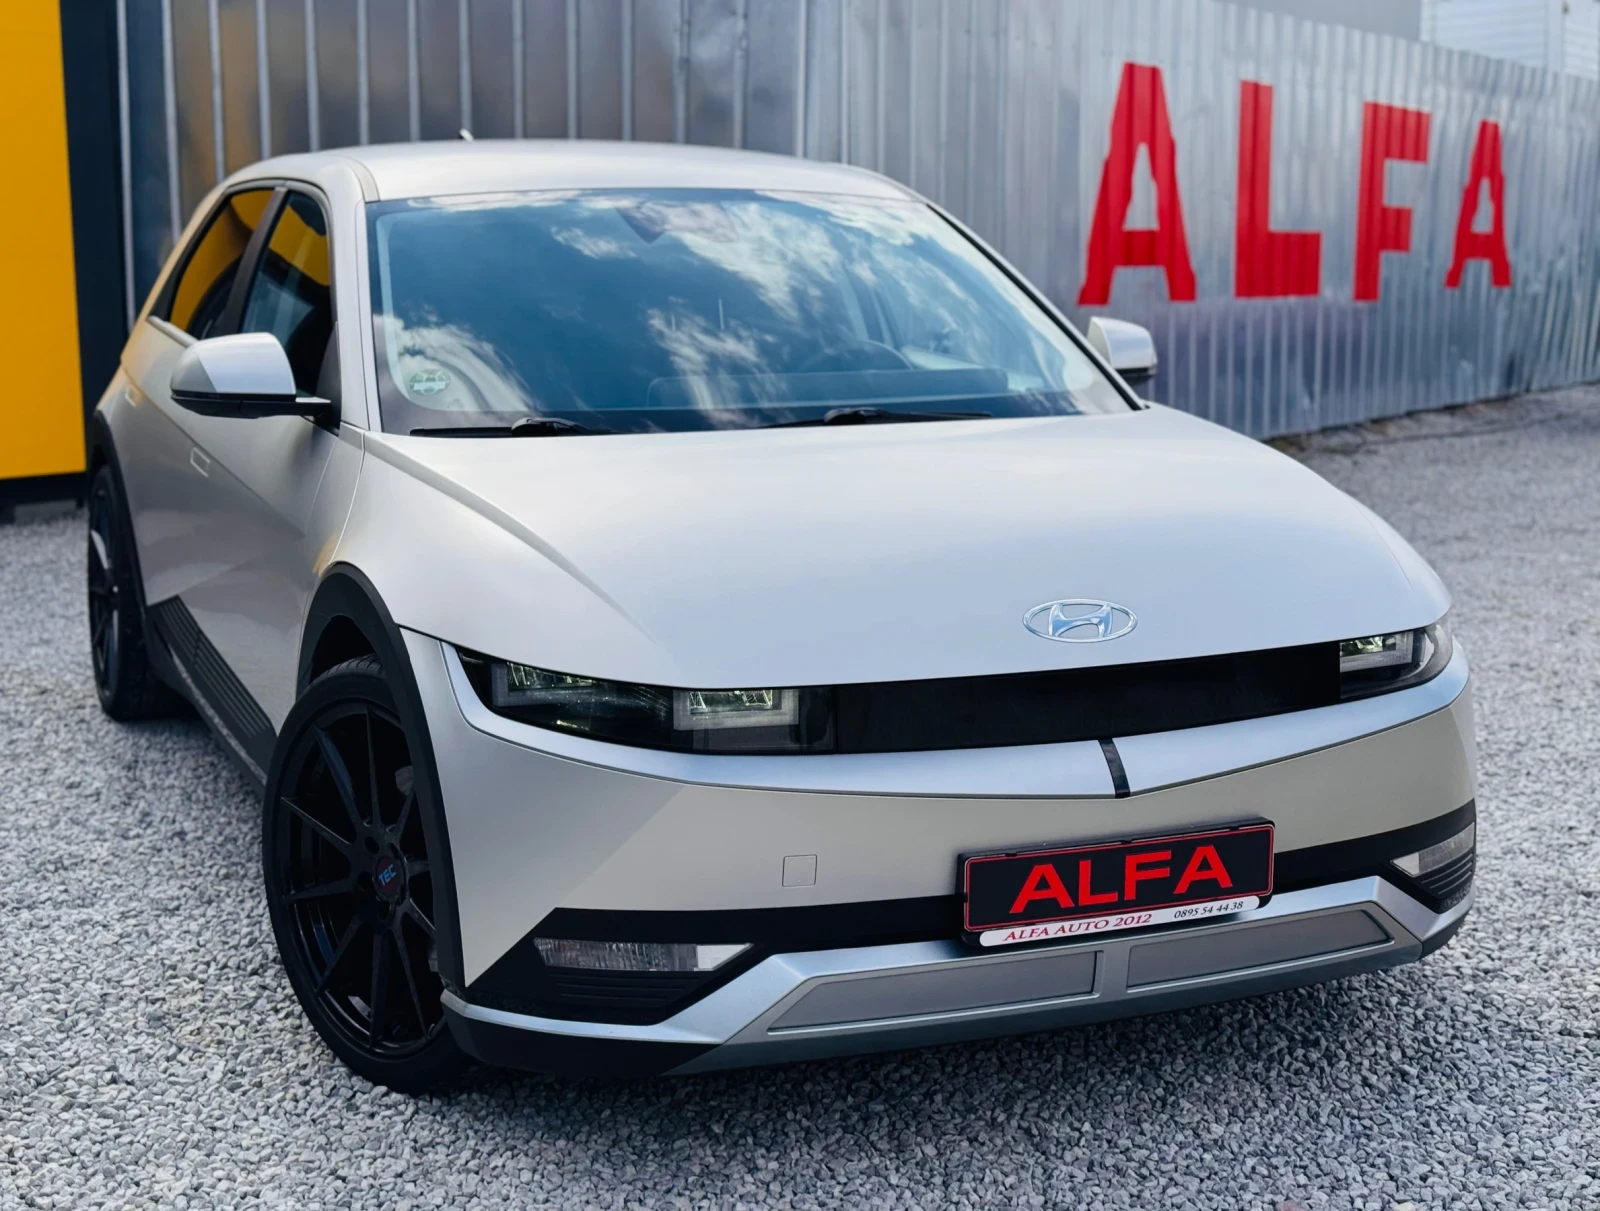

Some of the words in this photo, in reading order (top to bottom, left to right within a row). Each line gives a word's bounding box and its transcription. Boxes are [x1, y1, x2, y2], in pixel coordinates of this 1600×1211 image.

[1076, 61, 1512, 306] ALFA
[378, 863, 397, 886] TEC
[1009, 844, 1233, 914] ALFA
[1173, 907, 1199, 918] 0895
[1200, 905, 1213, 915] 54
[1216, 903, 1229, 912] 44
[1230, 901, 1243, 910] 38
[1002, 927, 1049, 941] ALFA
[1053, 919, 1110, 935] AUTO
[1114, 914, 1152, 926] 2012
